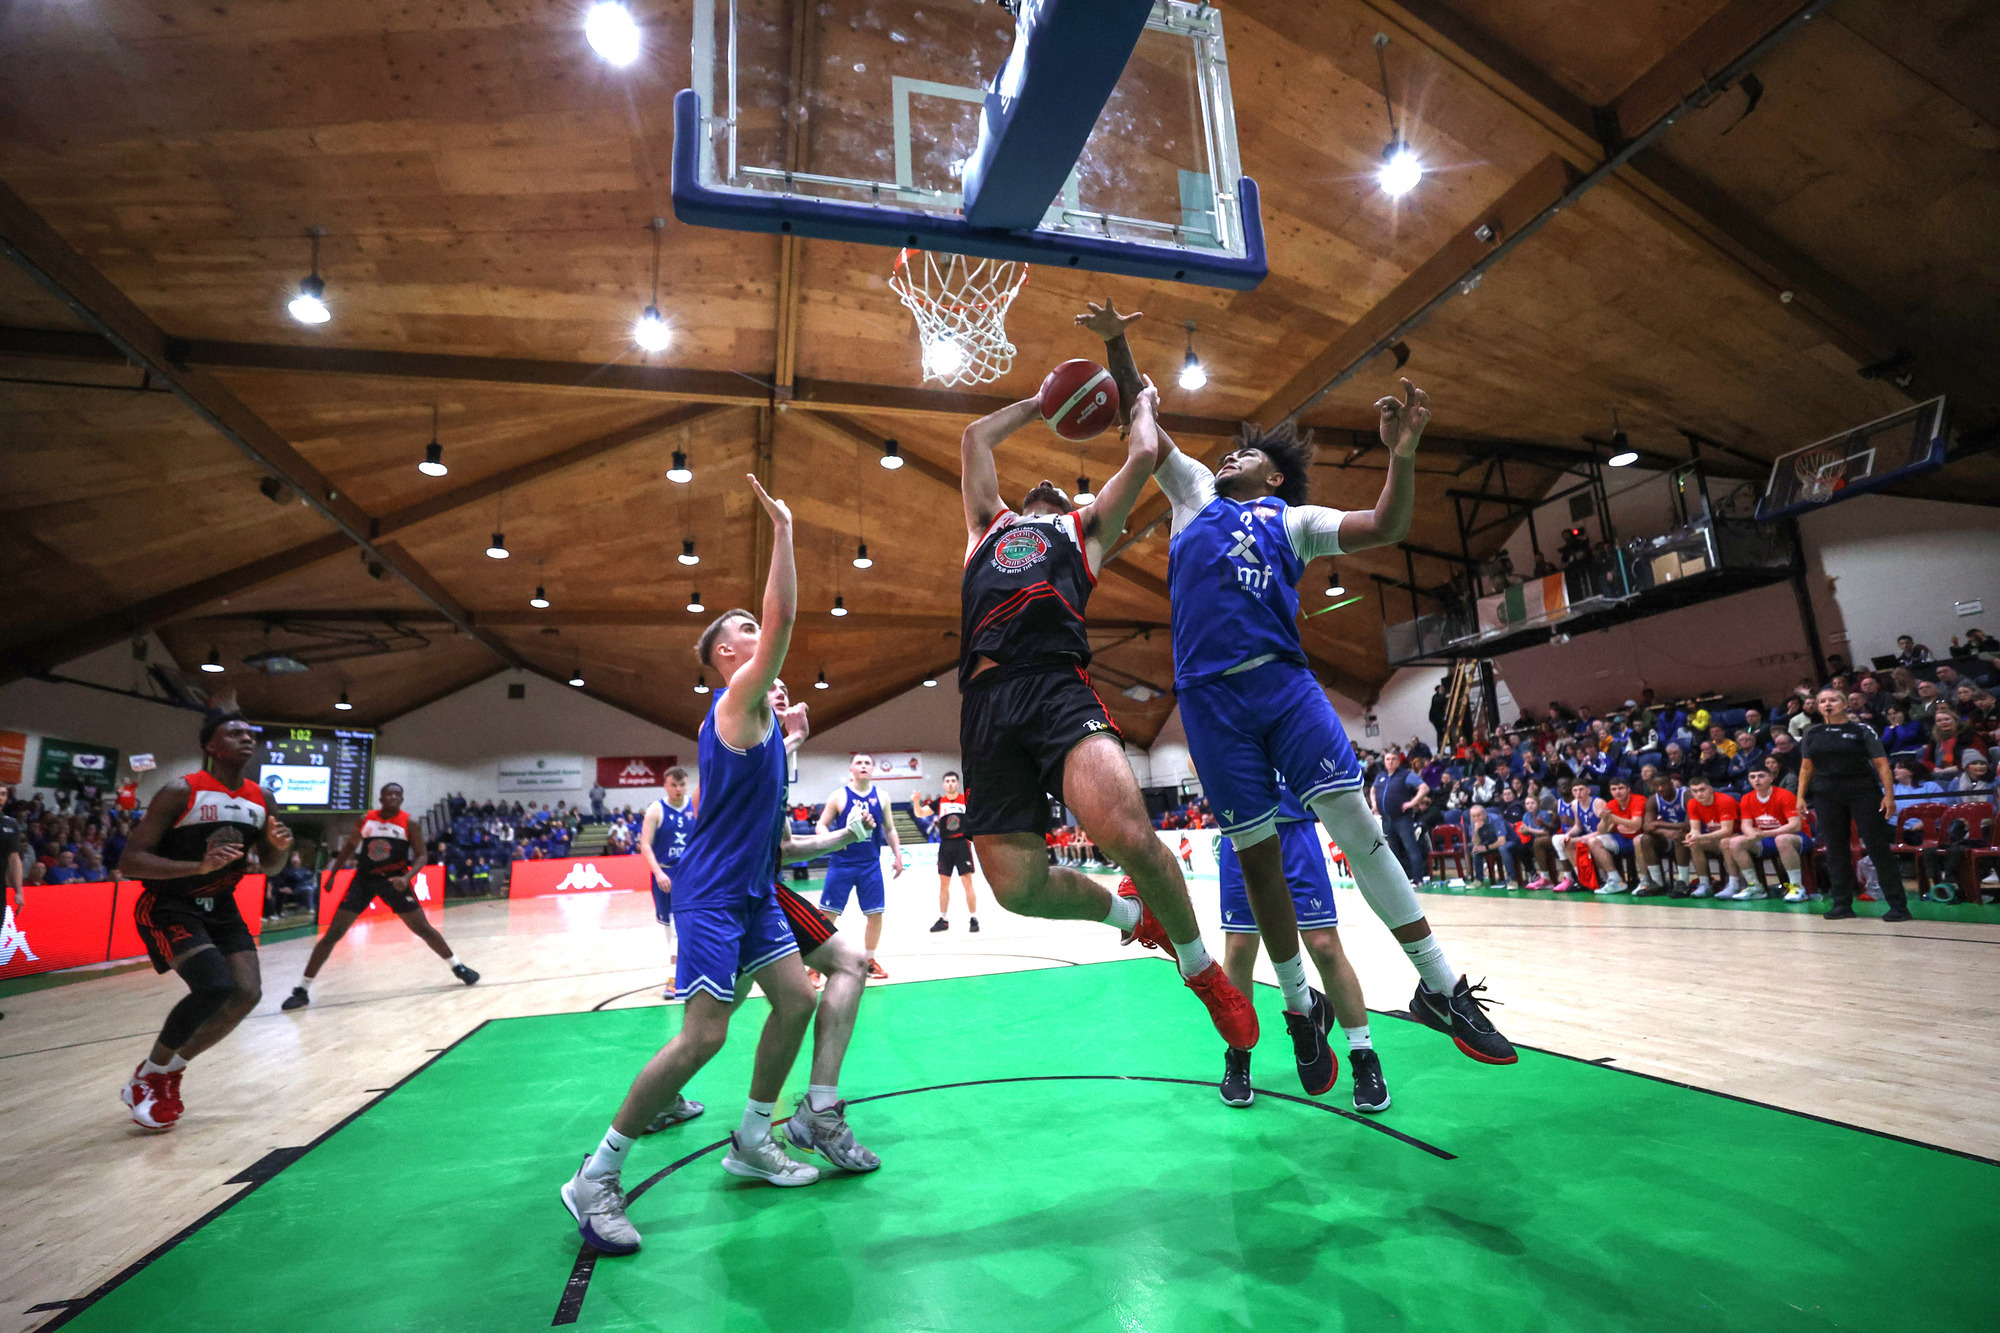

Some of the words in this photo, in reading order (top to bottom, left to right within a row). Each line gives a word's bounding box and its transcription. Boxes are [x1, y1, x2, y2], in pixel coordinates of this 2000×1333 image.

[996, 565, 1007, 574] PUB
[1023, 563, 1033, 571] THE
[290, 728, 313, 741] 1:02
[270, 751, 285, 764] 72
[309, 753, 324, 766] 73
[619, 778, 655, 786] Kappa
[200, 804, 219, 821] 11
[677, 816, 684, 829] 5
